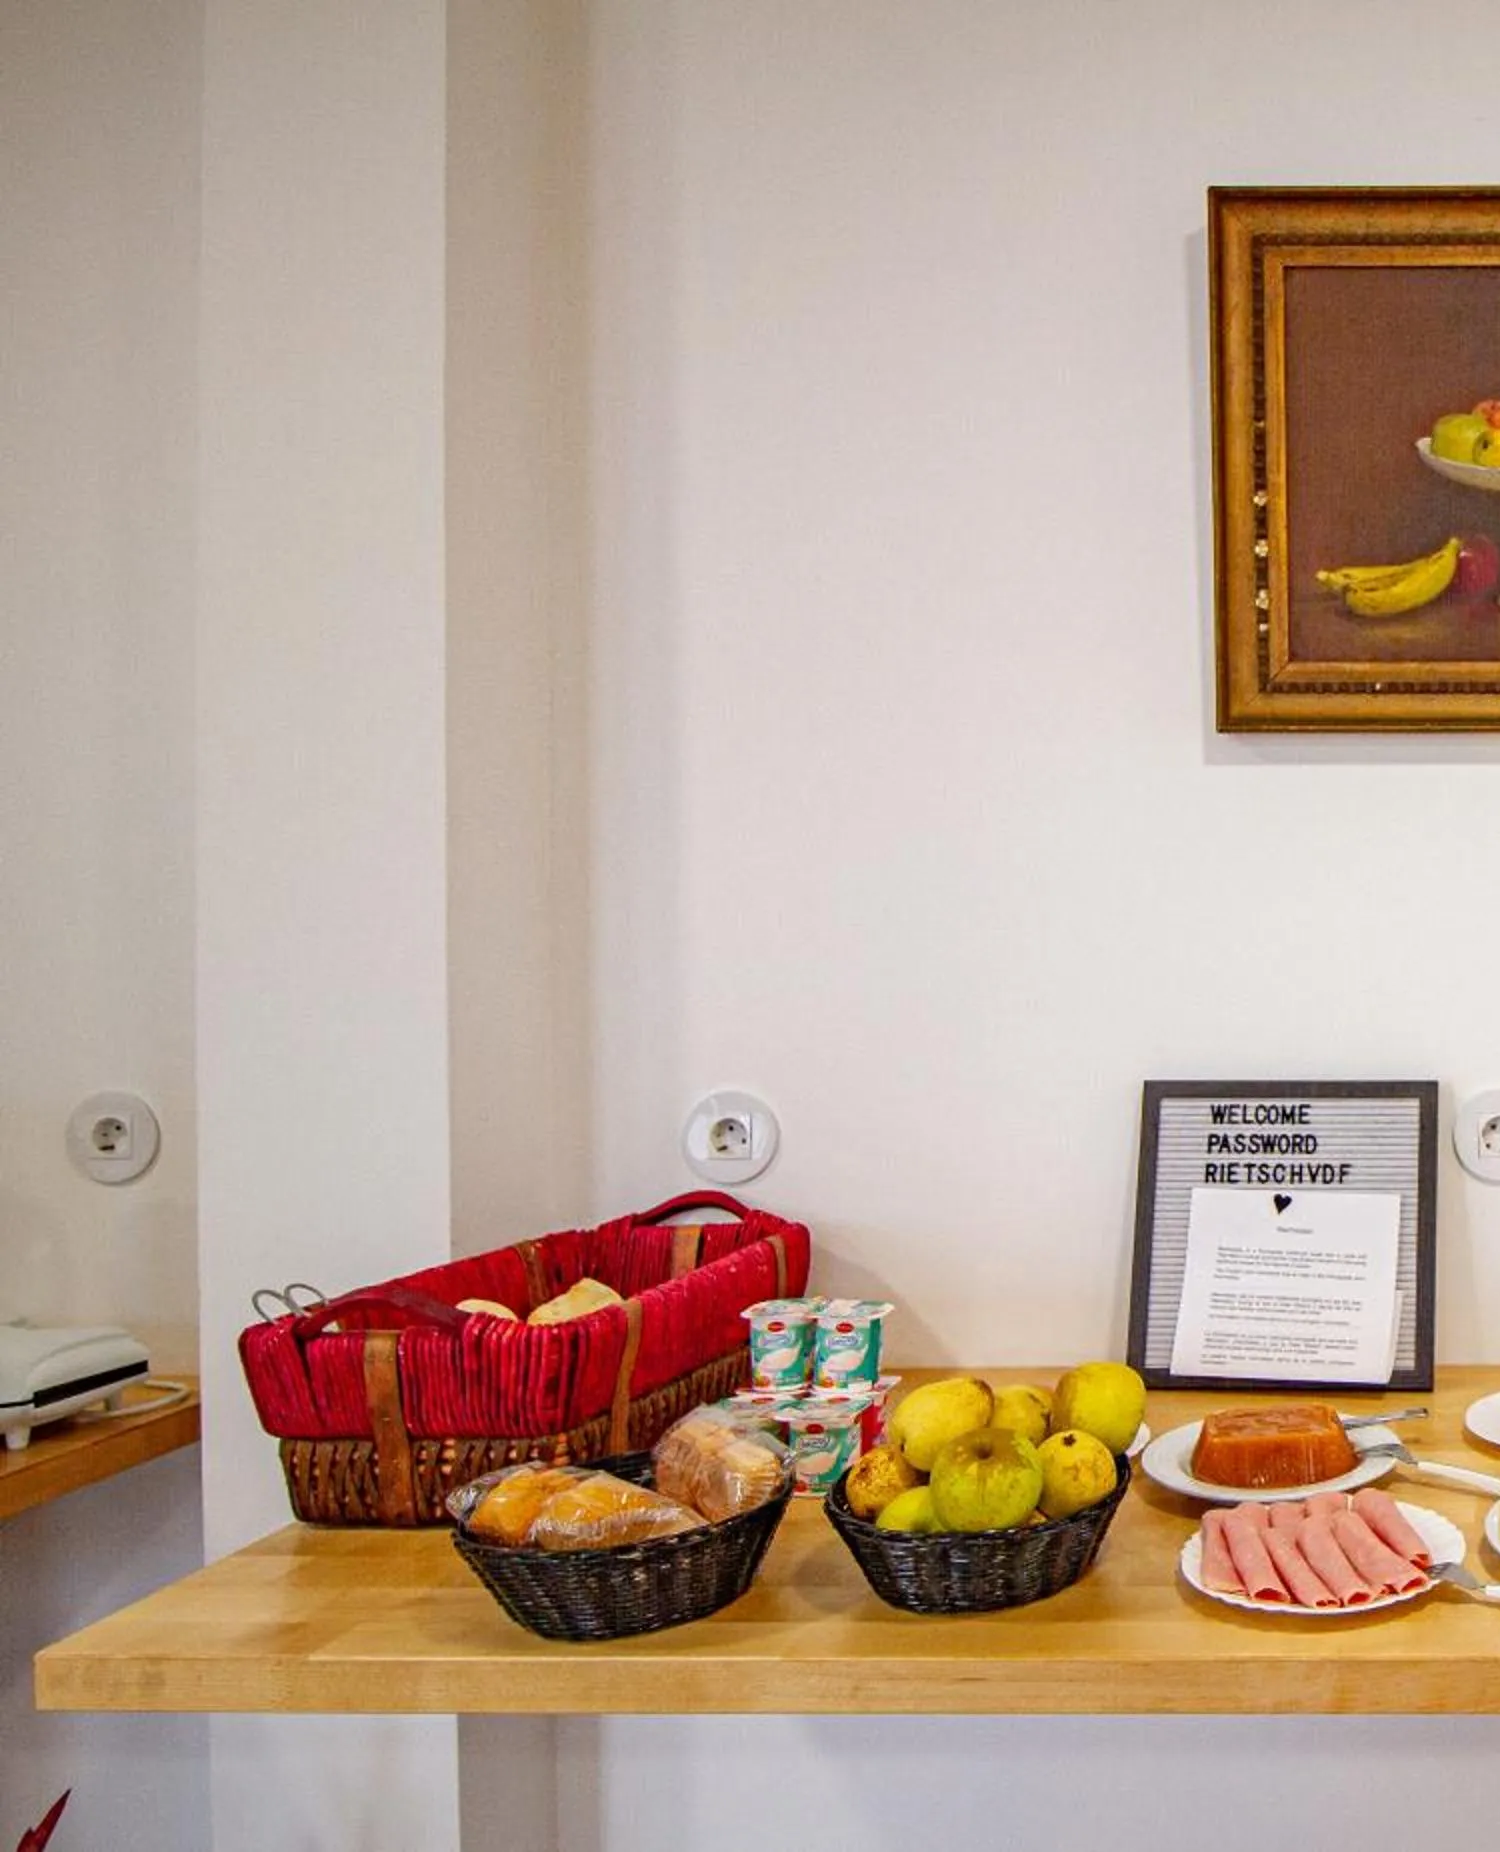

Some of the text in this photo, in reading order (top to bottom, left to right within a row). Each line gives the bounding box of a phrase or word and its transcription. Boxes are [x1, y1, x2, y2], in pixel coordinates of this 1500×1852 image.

[1210, 1104, 1312, 1124] WELCOME
[1207, 1133, 1318, 1154] PASSWORD
[1205, 1163, 1352, 1184] RIETSCHVDF
